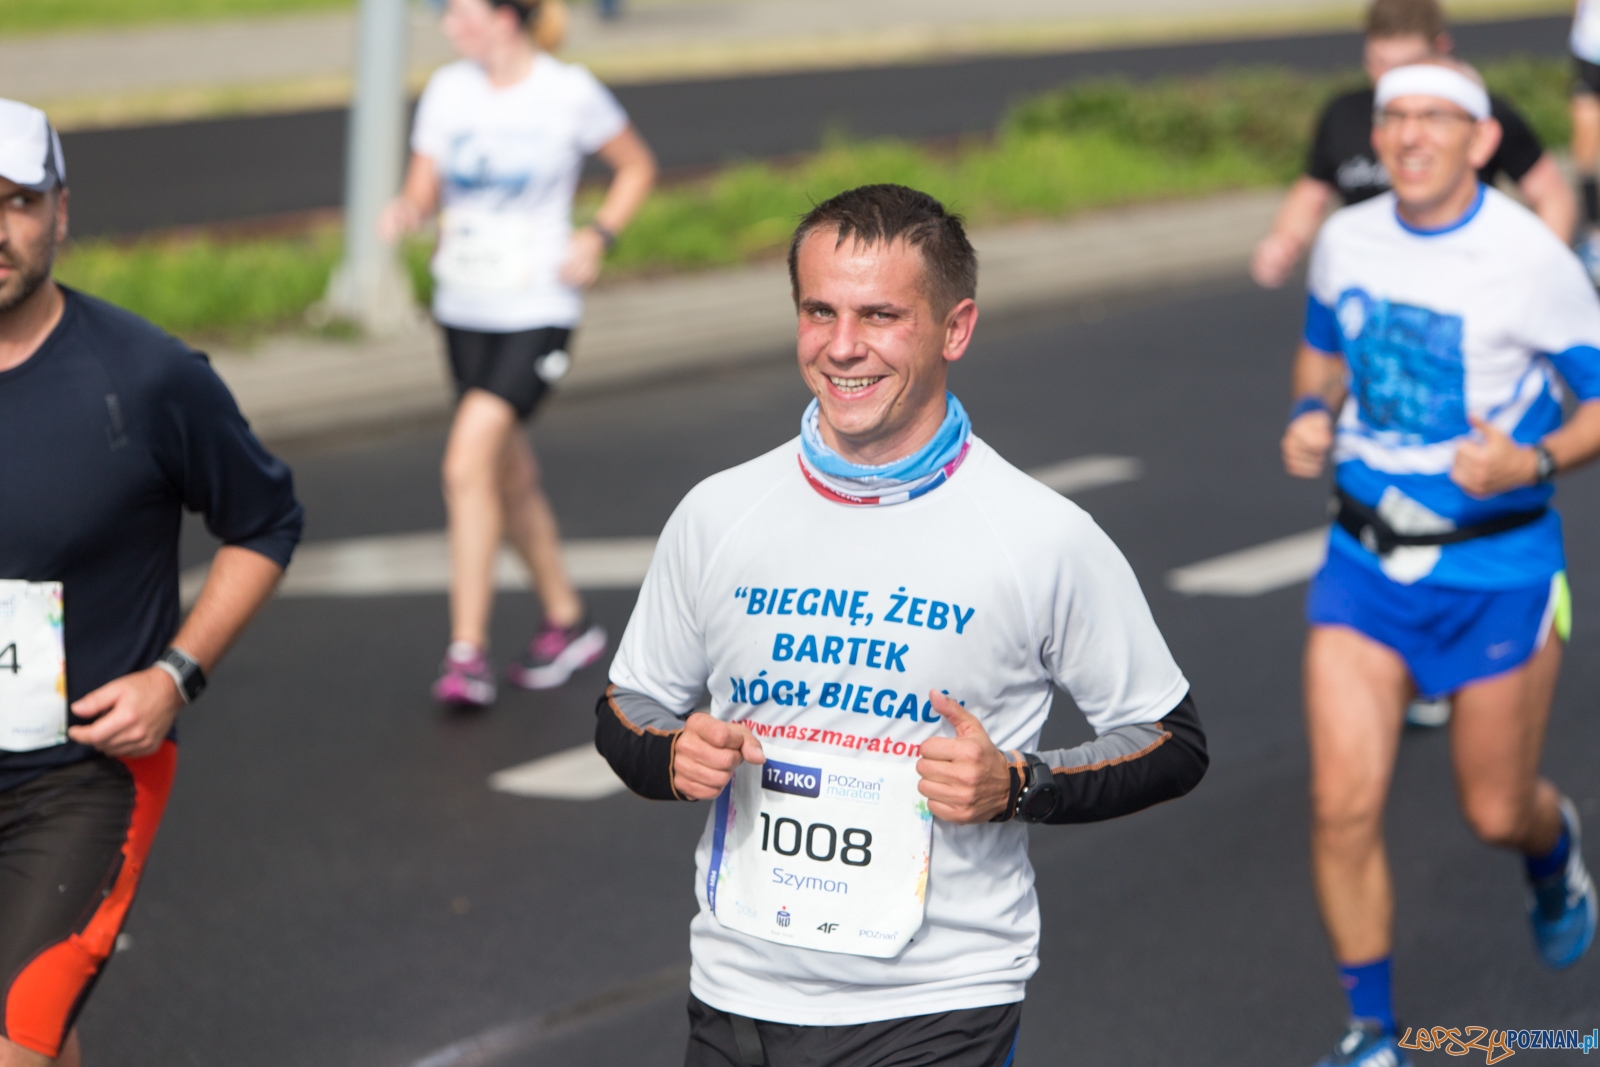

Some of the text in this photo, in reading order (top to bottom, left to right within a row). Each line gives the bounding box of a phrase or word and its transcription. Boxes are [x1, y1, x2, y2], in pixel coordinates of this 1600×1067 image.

[884, 587, 975, 634] ŻEBY
[772, 633, 909, 673] BARTEK
[826, 786, 880, 801] maraton
[760, 811, 873, 867] 1008
[772, 867, 848, 894] Szymon
